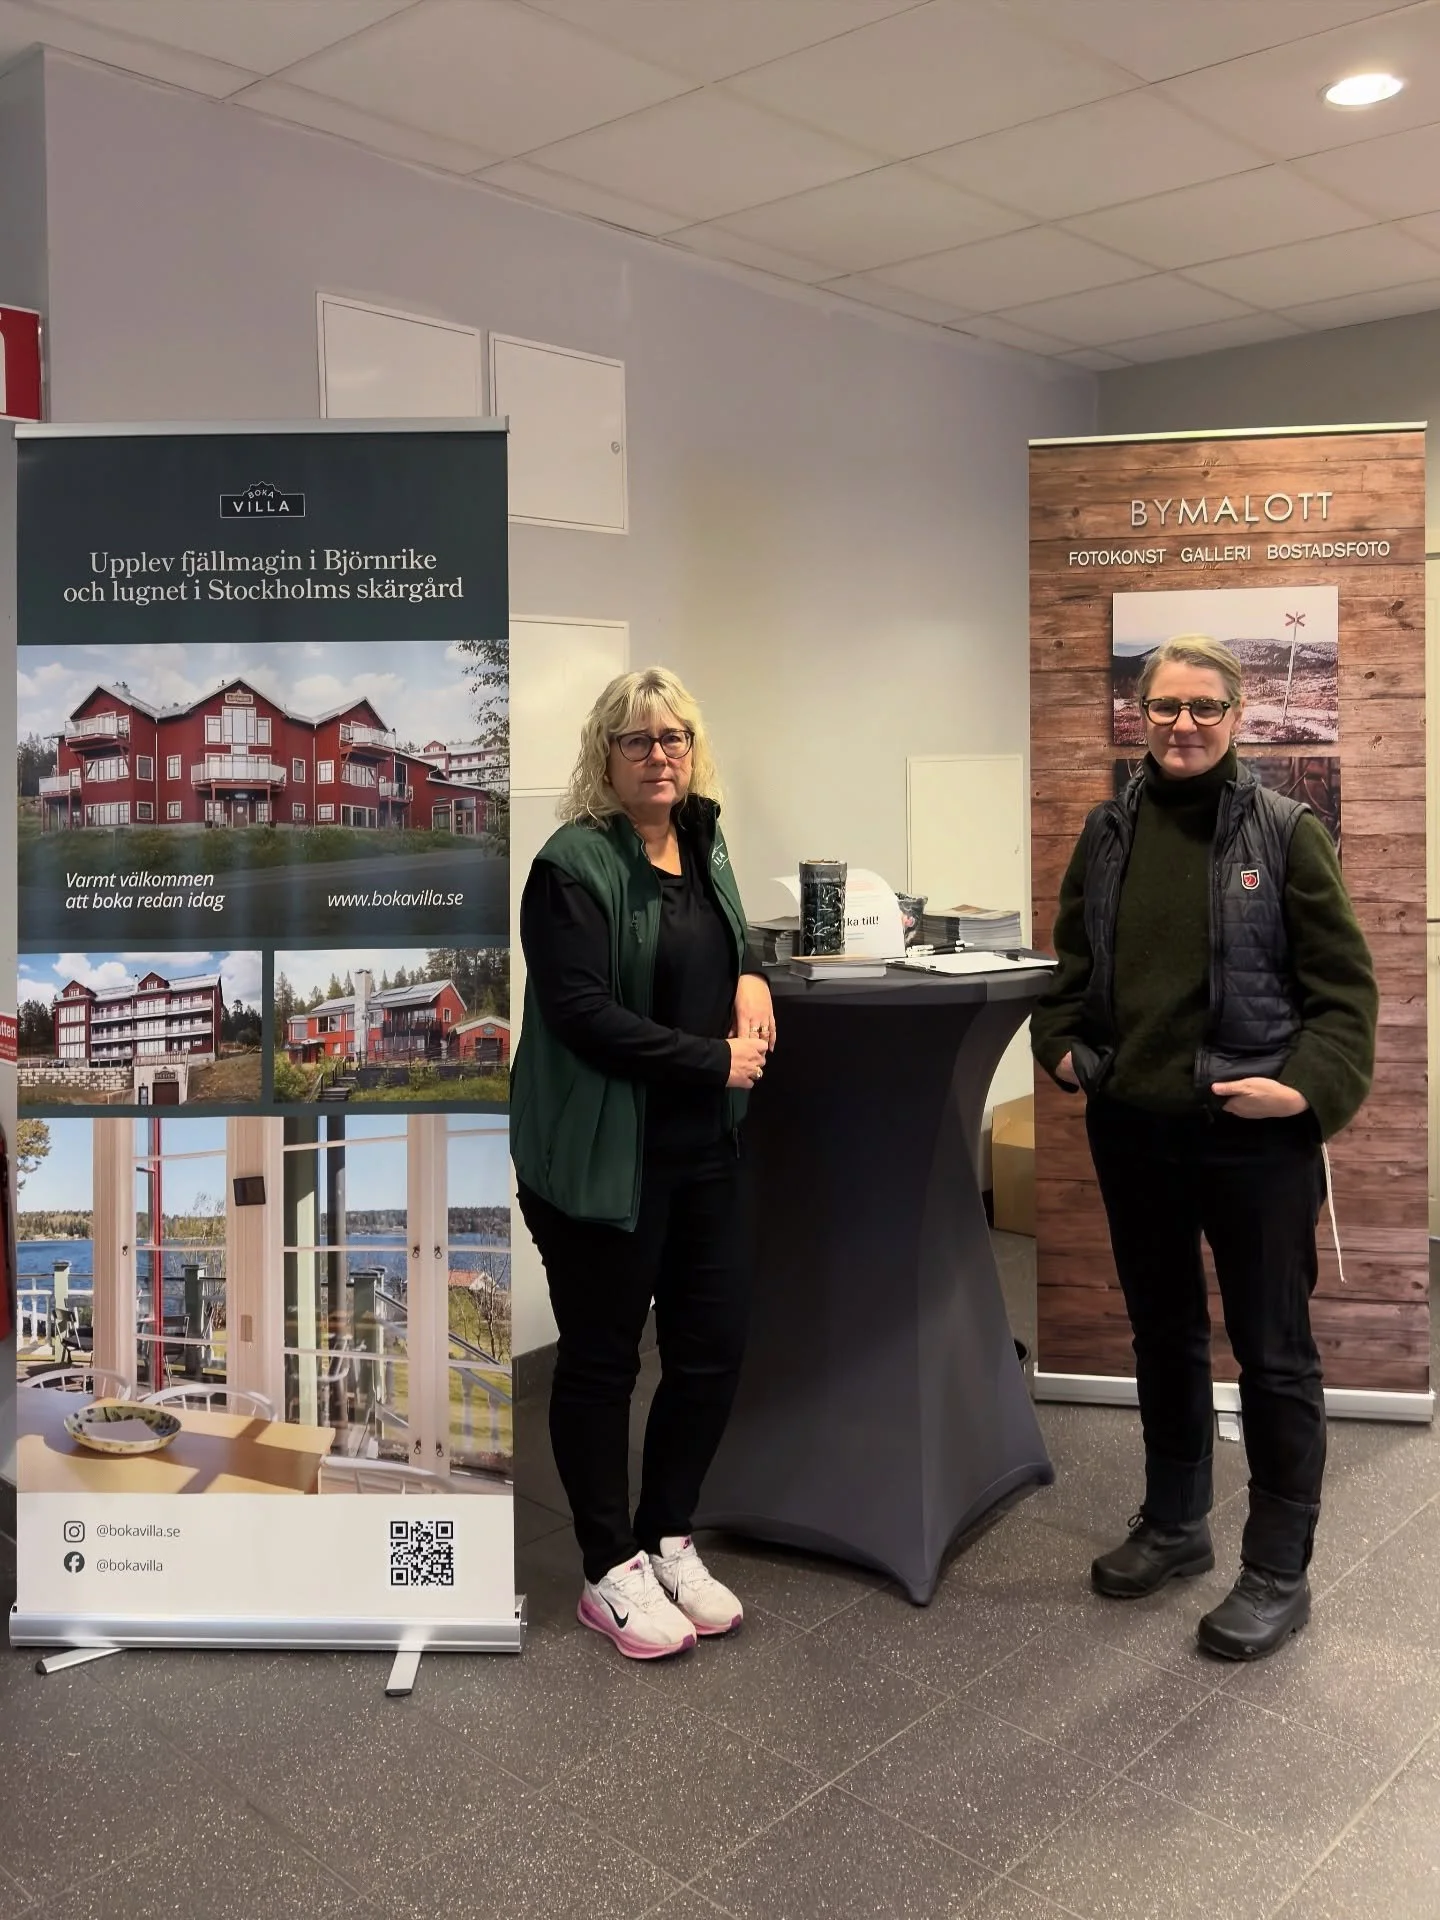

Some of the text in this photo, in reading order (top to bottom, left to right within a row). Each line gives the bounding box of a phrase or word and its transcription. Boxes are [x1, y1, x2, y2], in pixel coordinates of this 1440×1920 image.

[248, 489, 274, 499] BOKA
[233, 500, 289, 512] VILLA
[1131, 491, 1333, 526] BYMALOTT
[1069, 540, 1390, 566] FOTOKONST GALLERI BOSTADSFOTO
[89, 548, 437, 579] Upplev fjällmagin i Björnrike
[63, 576, 464, 606] och lugnet i Stockholms skärgård
[66, 871, 215, 888] Varmt välkommen
[65, 891, 226, 912] att boka redan idag
[327, 889, 465, 907] www.bokavilla.se
[862, 915, 880, 926] till!
[96, 1523, 181, 1538] @bokavilla.se
[96, 1558, 163, 1573] @bokavilla
